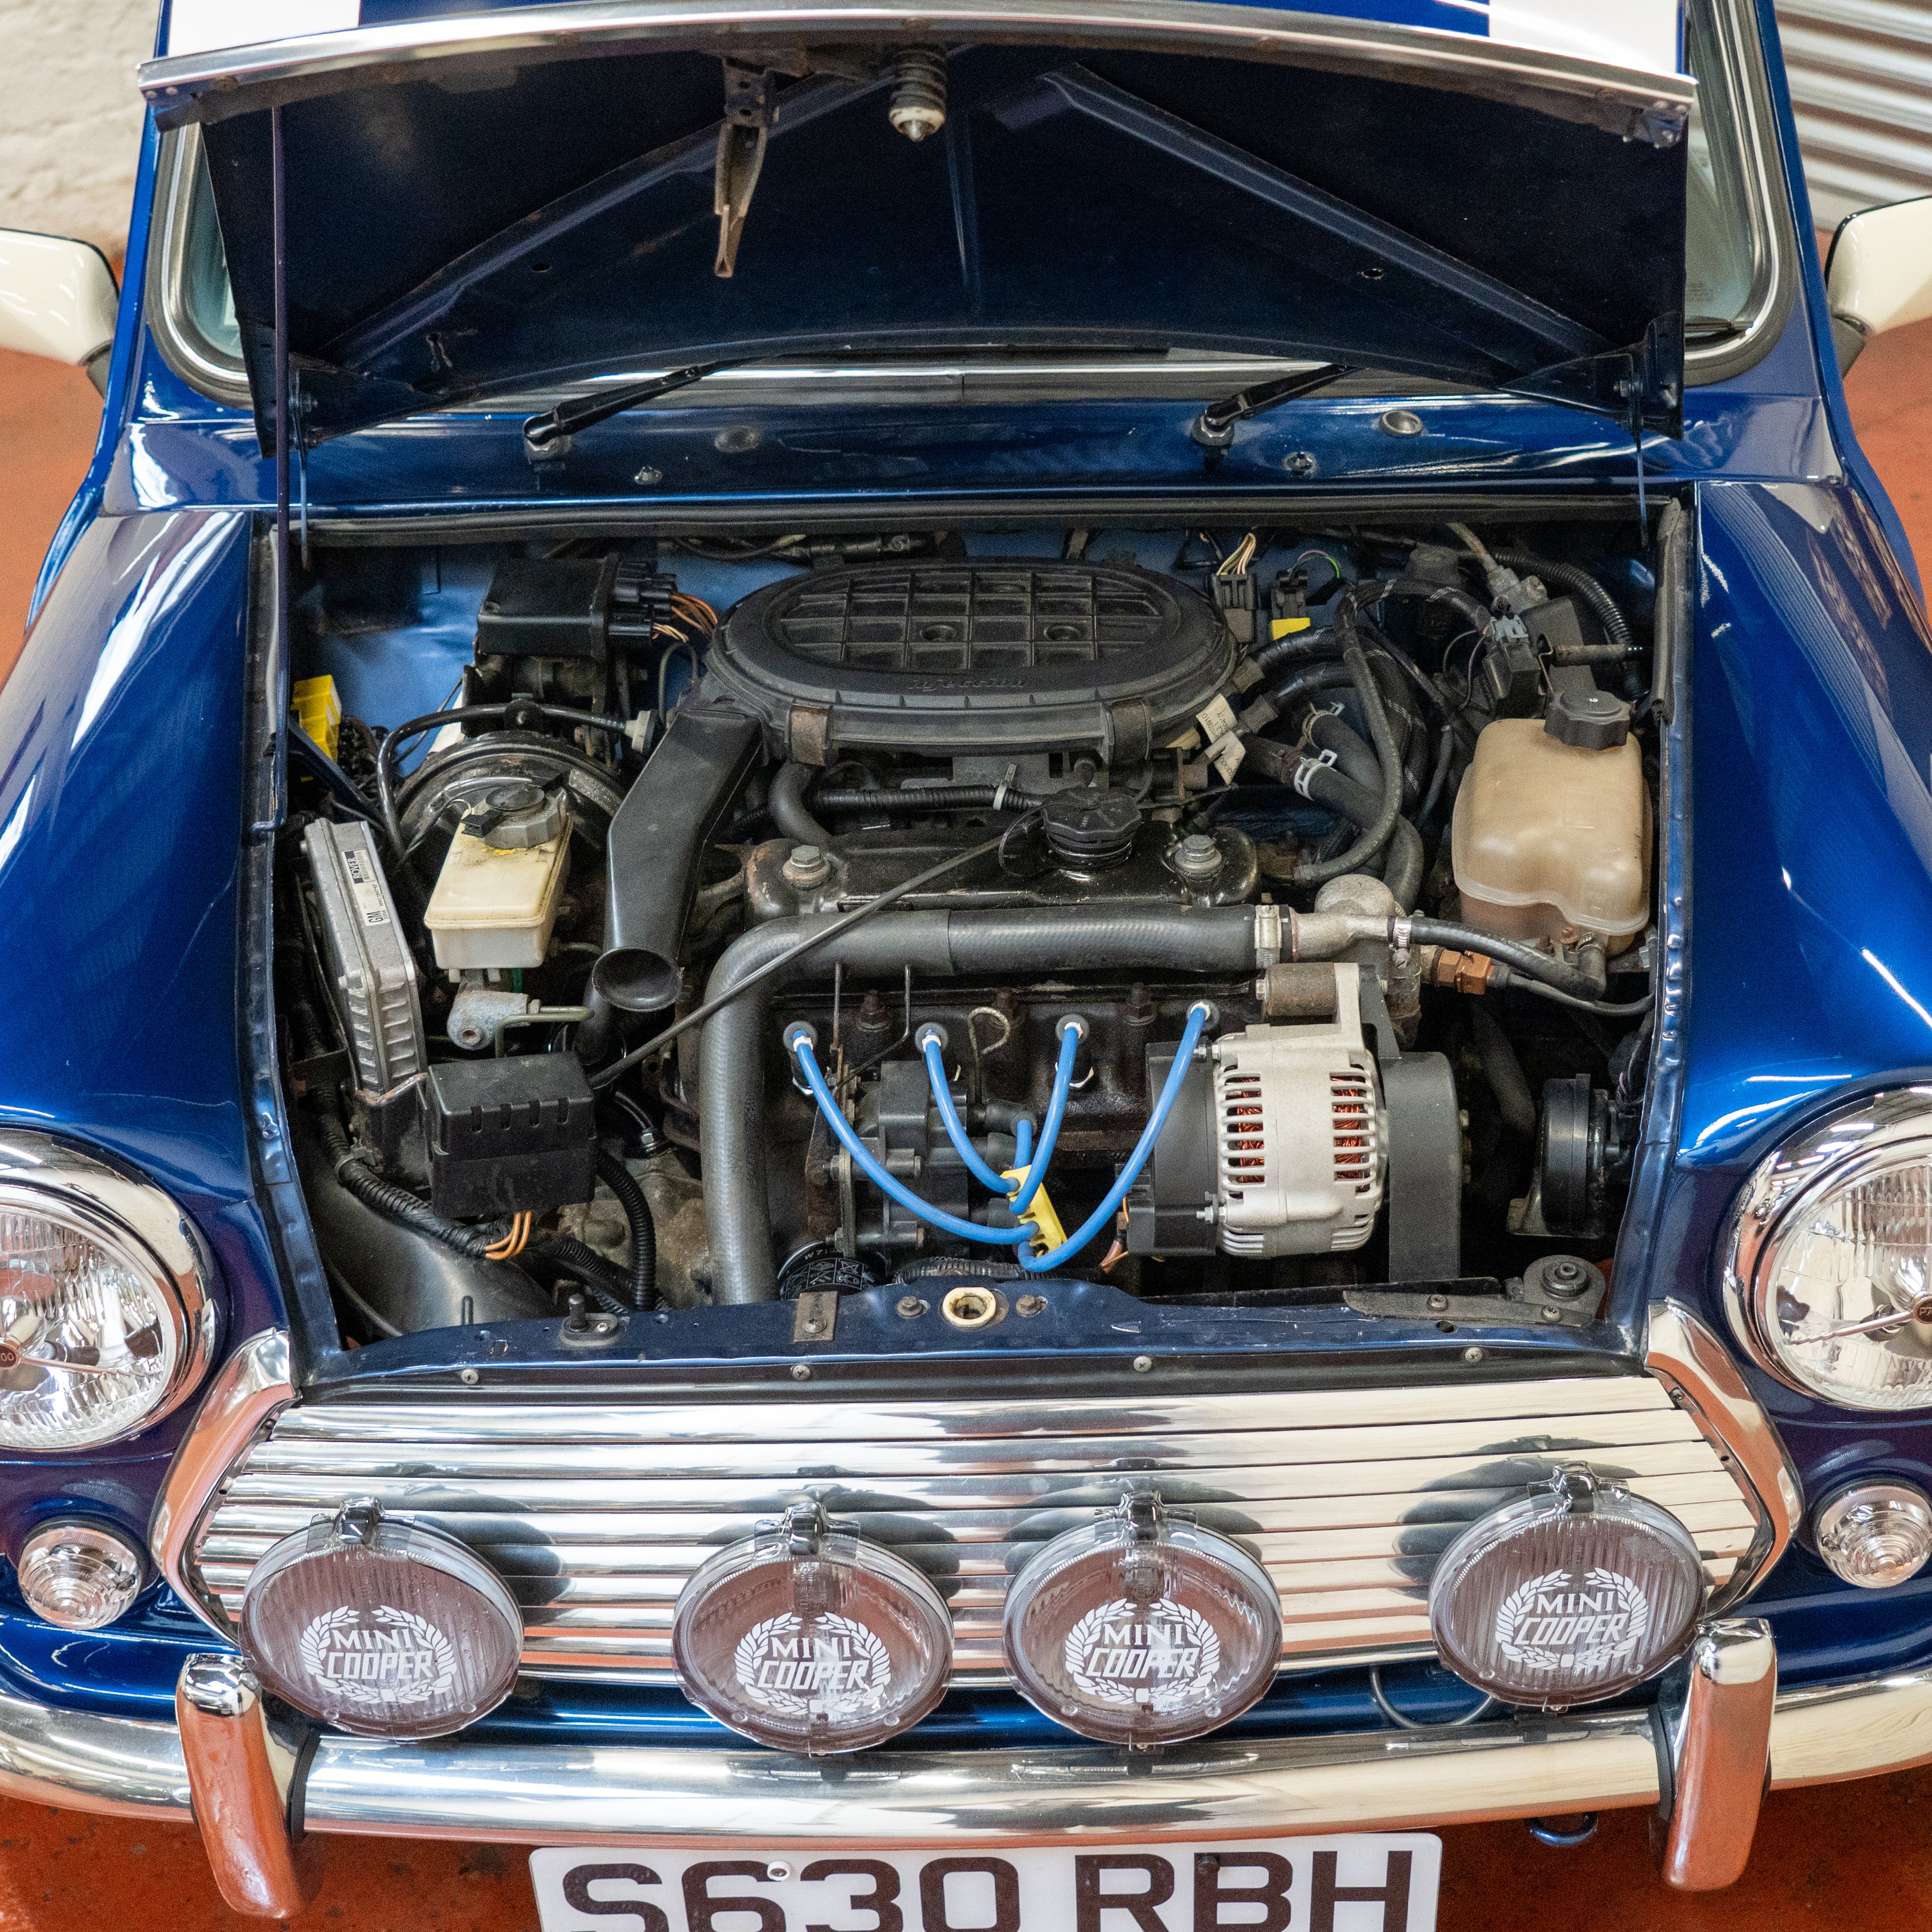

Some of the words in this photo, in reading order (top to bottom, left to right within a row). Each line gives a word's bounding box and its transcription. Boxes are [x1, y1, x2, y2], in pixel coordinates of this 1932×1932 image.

[347, 857, 362, 879] ROVER
[366, 911, 384, 923] GM
[0, 1352, 14, 1361] 00
[1536, 1591, 1615, 1614] MINI
[332, 1629, 413, 1650] MINI
[1103, 1624, 1184, 1645] MINI
[1513, 1613, 1629, 1645] COOPER
[771, 1637, 852, 1658] MINI
[327, 1651, 434, 1679] COOPER
[1086, 1647, 1200, 1678] COOPER
[757, 1659, 869, 1689] COOPER
[562, 1857, 1021, 1932] S630
[1075, 1850, 1413, 1932] RBH
